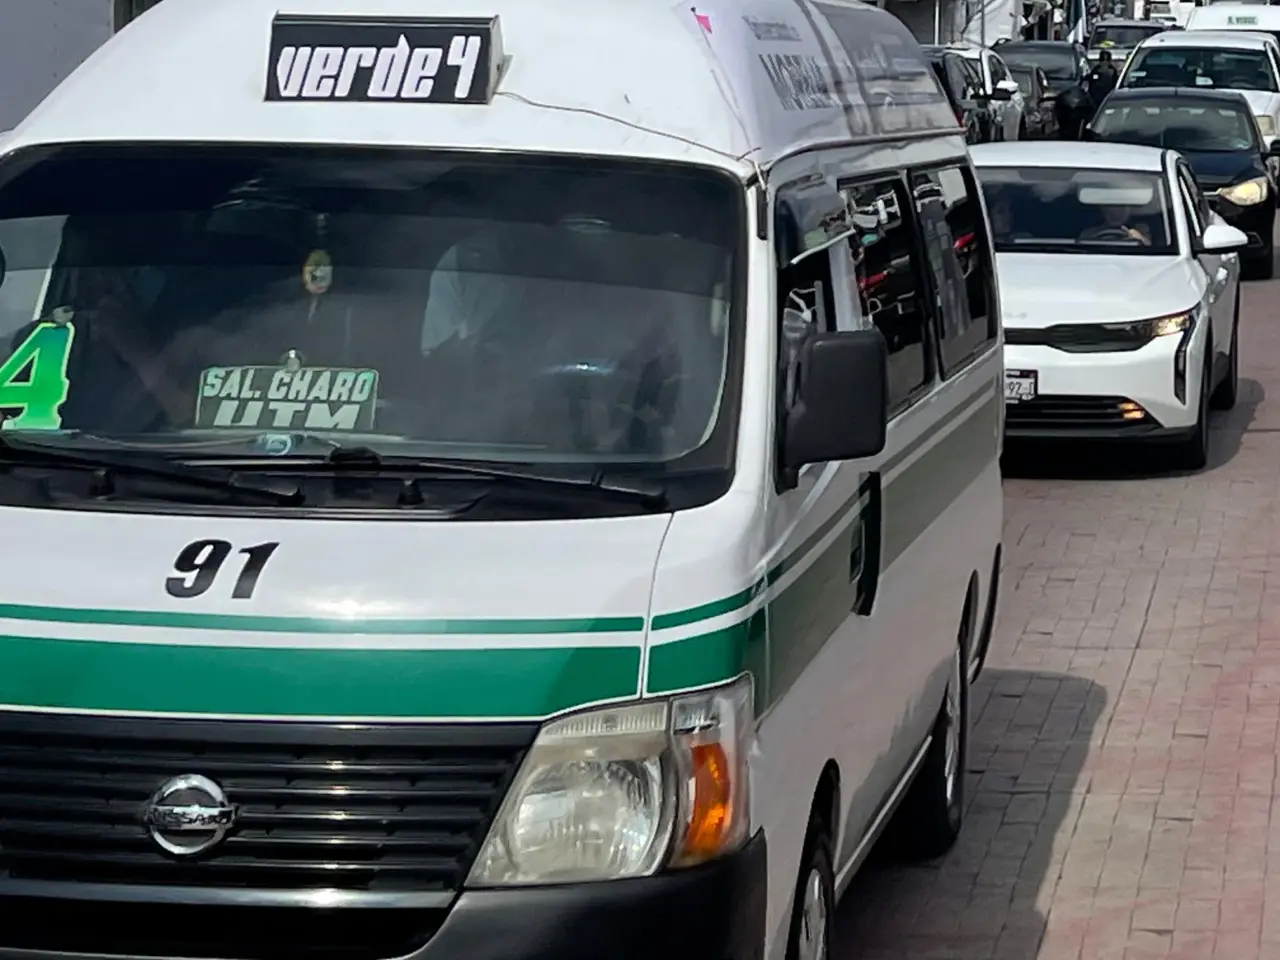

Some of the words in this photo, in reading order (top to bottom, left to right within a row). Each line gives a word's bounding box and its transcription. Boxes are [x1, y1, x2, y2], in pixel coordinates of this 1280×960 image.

[276, 33, 444, 98] verde
[201, 370, 262, 399] SAL.
[266, 369, 377, 402] CHARO
[213, 400, 361, 430] UTM
[164, 538, 281, 600] 91
